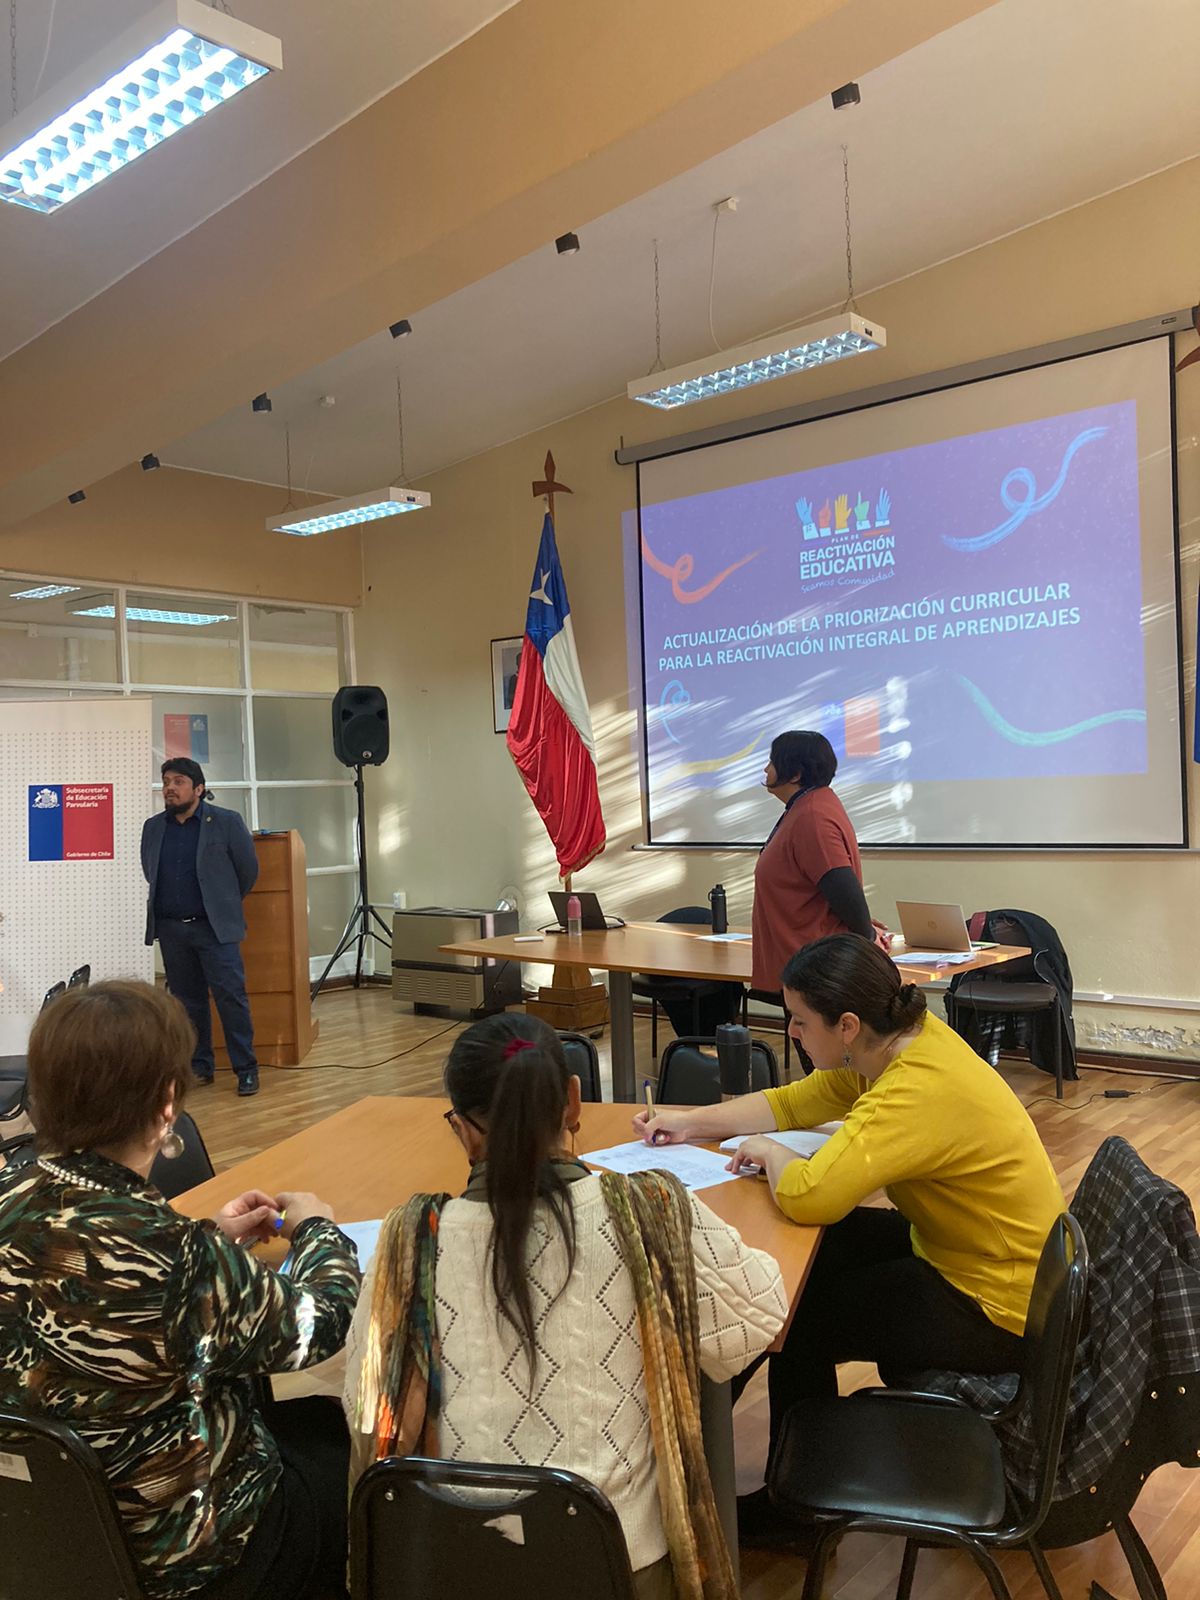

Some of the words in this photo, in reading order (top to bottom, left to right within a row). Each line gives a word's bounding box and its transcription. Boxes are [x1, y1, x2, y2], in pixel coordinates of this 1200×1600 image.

[800, 535, 895, 563] REACTIVACIÓN
[800, 550, 895, 580] EDUCATIVA
[837, 567, 895, 586] Comunidad
[663, 621, 773, 649] ACTUALIZACIÓN
[778, 619, 796, 635] DE
[801, 616, 820, 632] LA
[825, 597, 944, 629] PRIORIZACIÓN
[950, 582, 1071, 613] CURRICULAR
[659, 654, 693, 671] PARA
[697, 650, 713, 667] LA
[717, 636, 824, 665] REACTIVACIÓN
[829, 629, 910, 652] INTEGRAL
[915, 625, 937, 642] DE
[942, 607, 1080, 640] APRENDIZAJES
